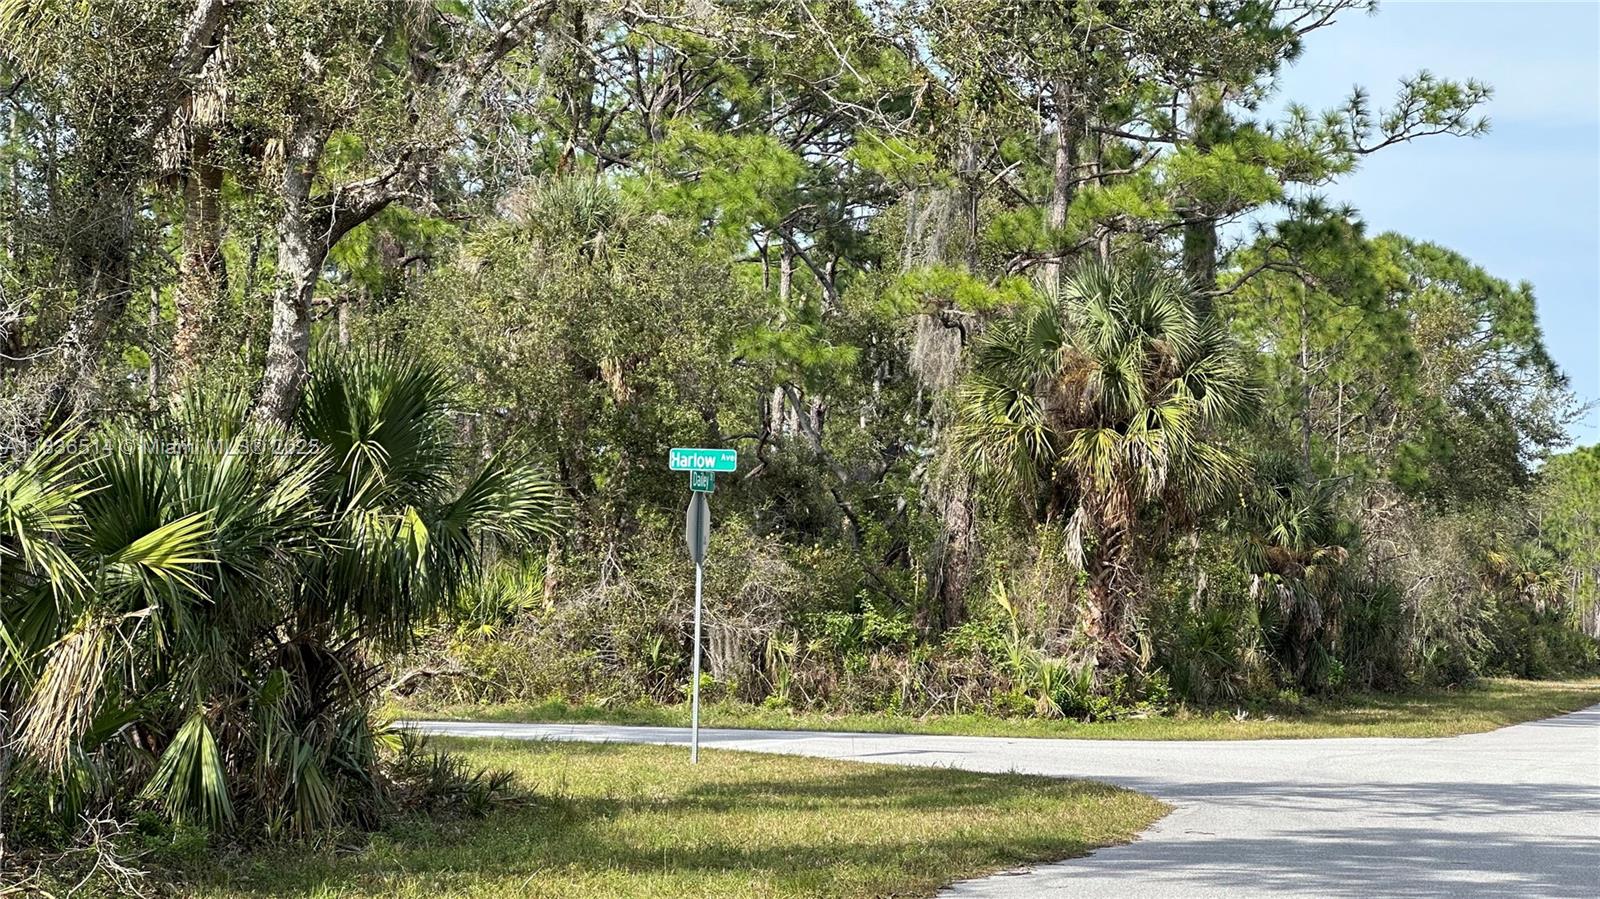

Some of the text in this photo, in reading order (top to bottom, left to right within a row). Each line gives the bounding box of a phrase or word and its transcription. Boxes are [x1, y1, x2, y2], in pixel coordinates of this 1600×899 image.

[671, 452, 735, 468] Harlow Ave
[693, 472, 709, 490] Dailey
